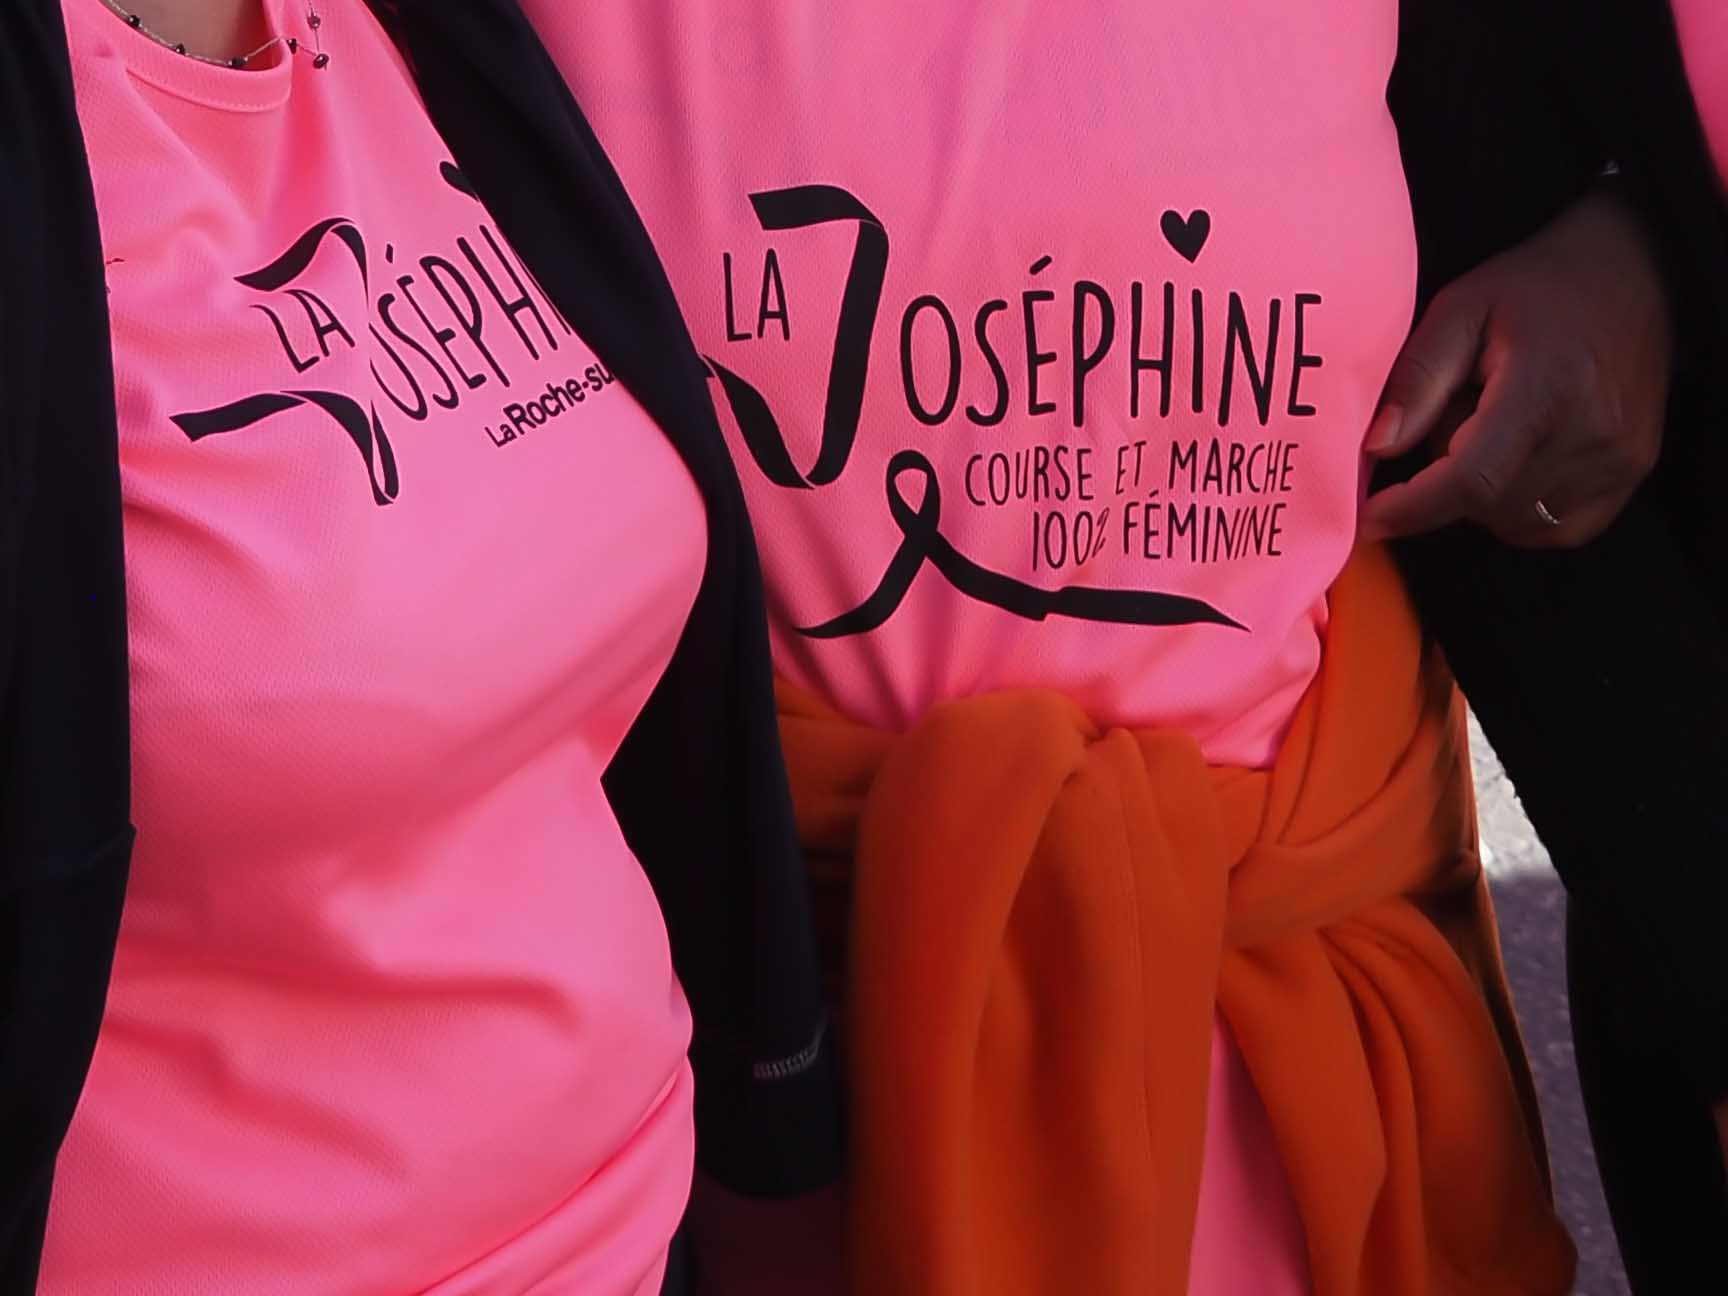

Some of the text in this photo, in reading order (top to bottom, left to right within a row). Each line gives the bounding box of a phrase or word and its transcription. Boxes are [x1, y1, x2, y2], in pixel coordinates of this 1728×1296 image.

[249, 288, 356, 374] LA
[703, 184, 1324, 490] LA JOSÉPHINE
[965, 437, 1299, 506] COURSE ET MARCHE
[1122, 489, 1287, 564] FÉMININE
